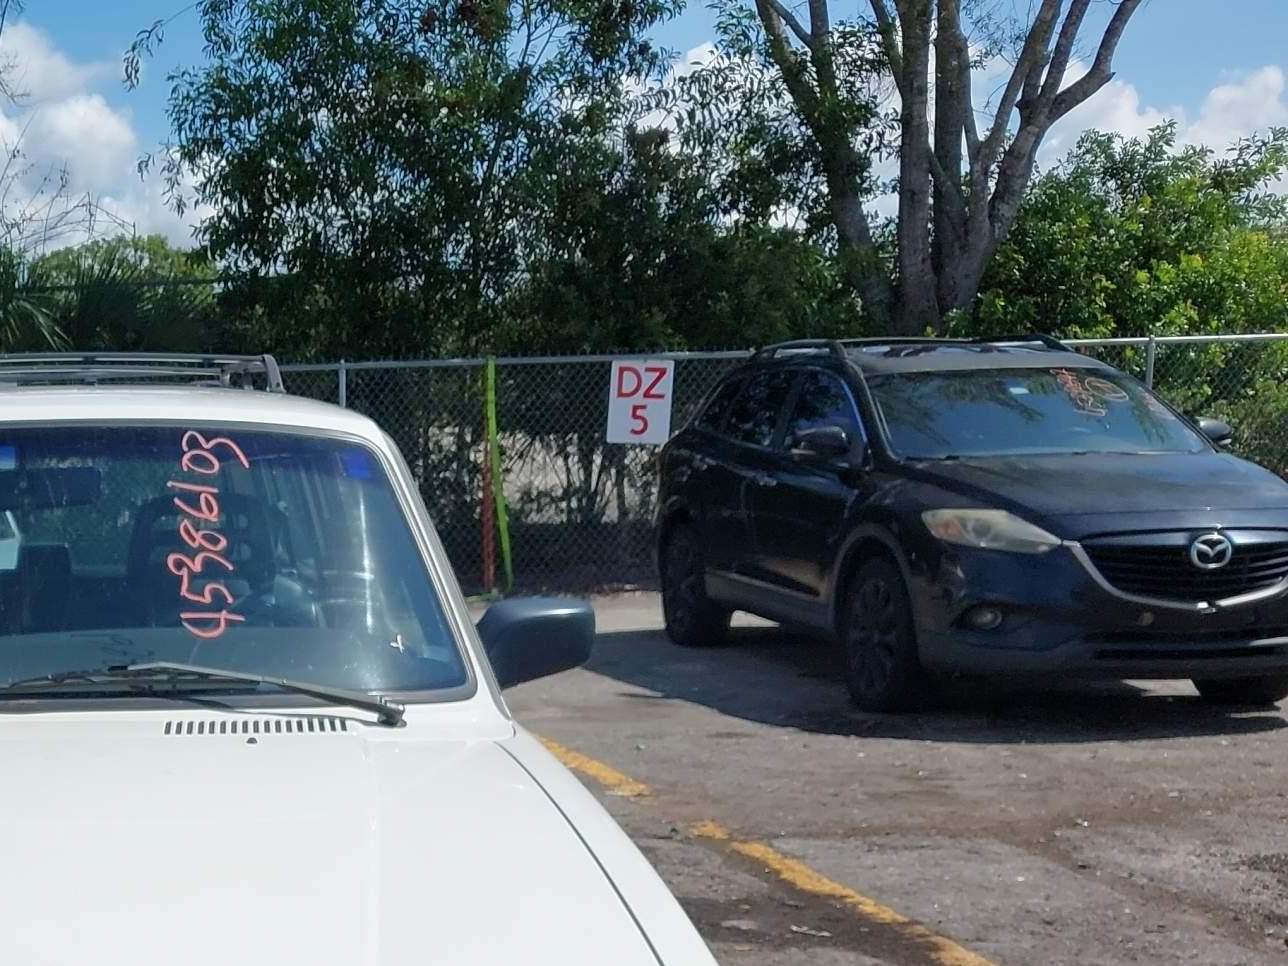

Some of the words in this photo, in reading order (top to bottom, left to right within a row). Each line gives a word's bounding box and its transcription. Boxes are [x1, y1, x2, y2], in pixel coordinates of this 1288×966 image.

[616, 366, 668, 400] DZ
[630, 404, 649, 436] 5
[167, 429, 249, 639] 45386103
